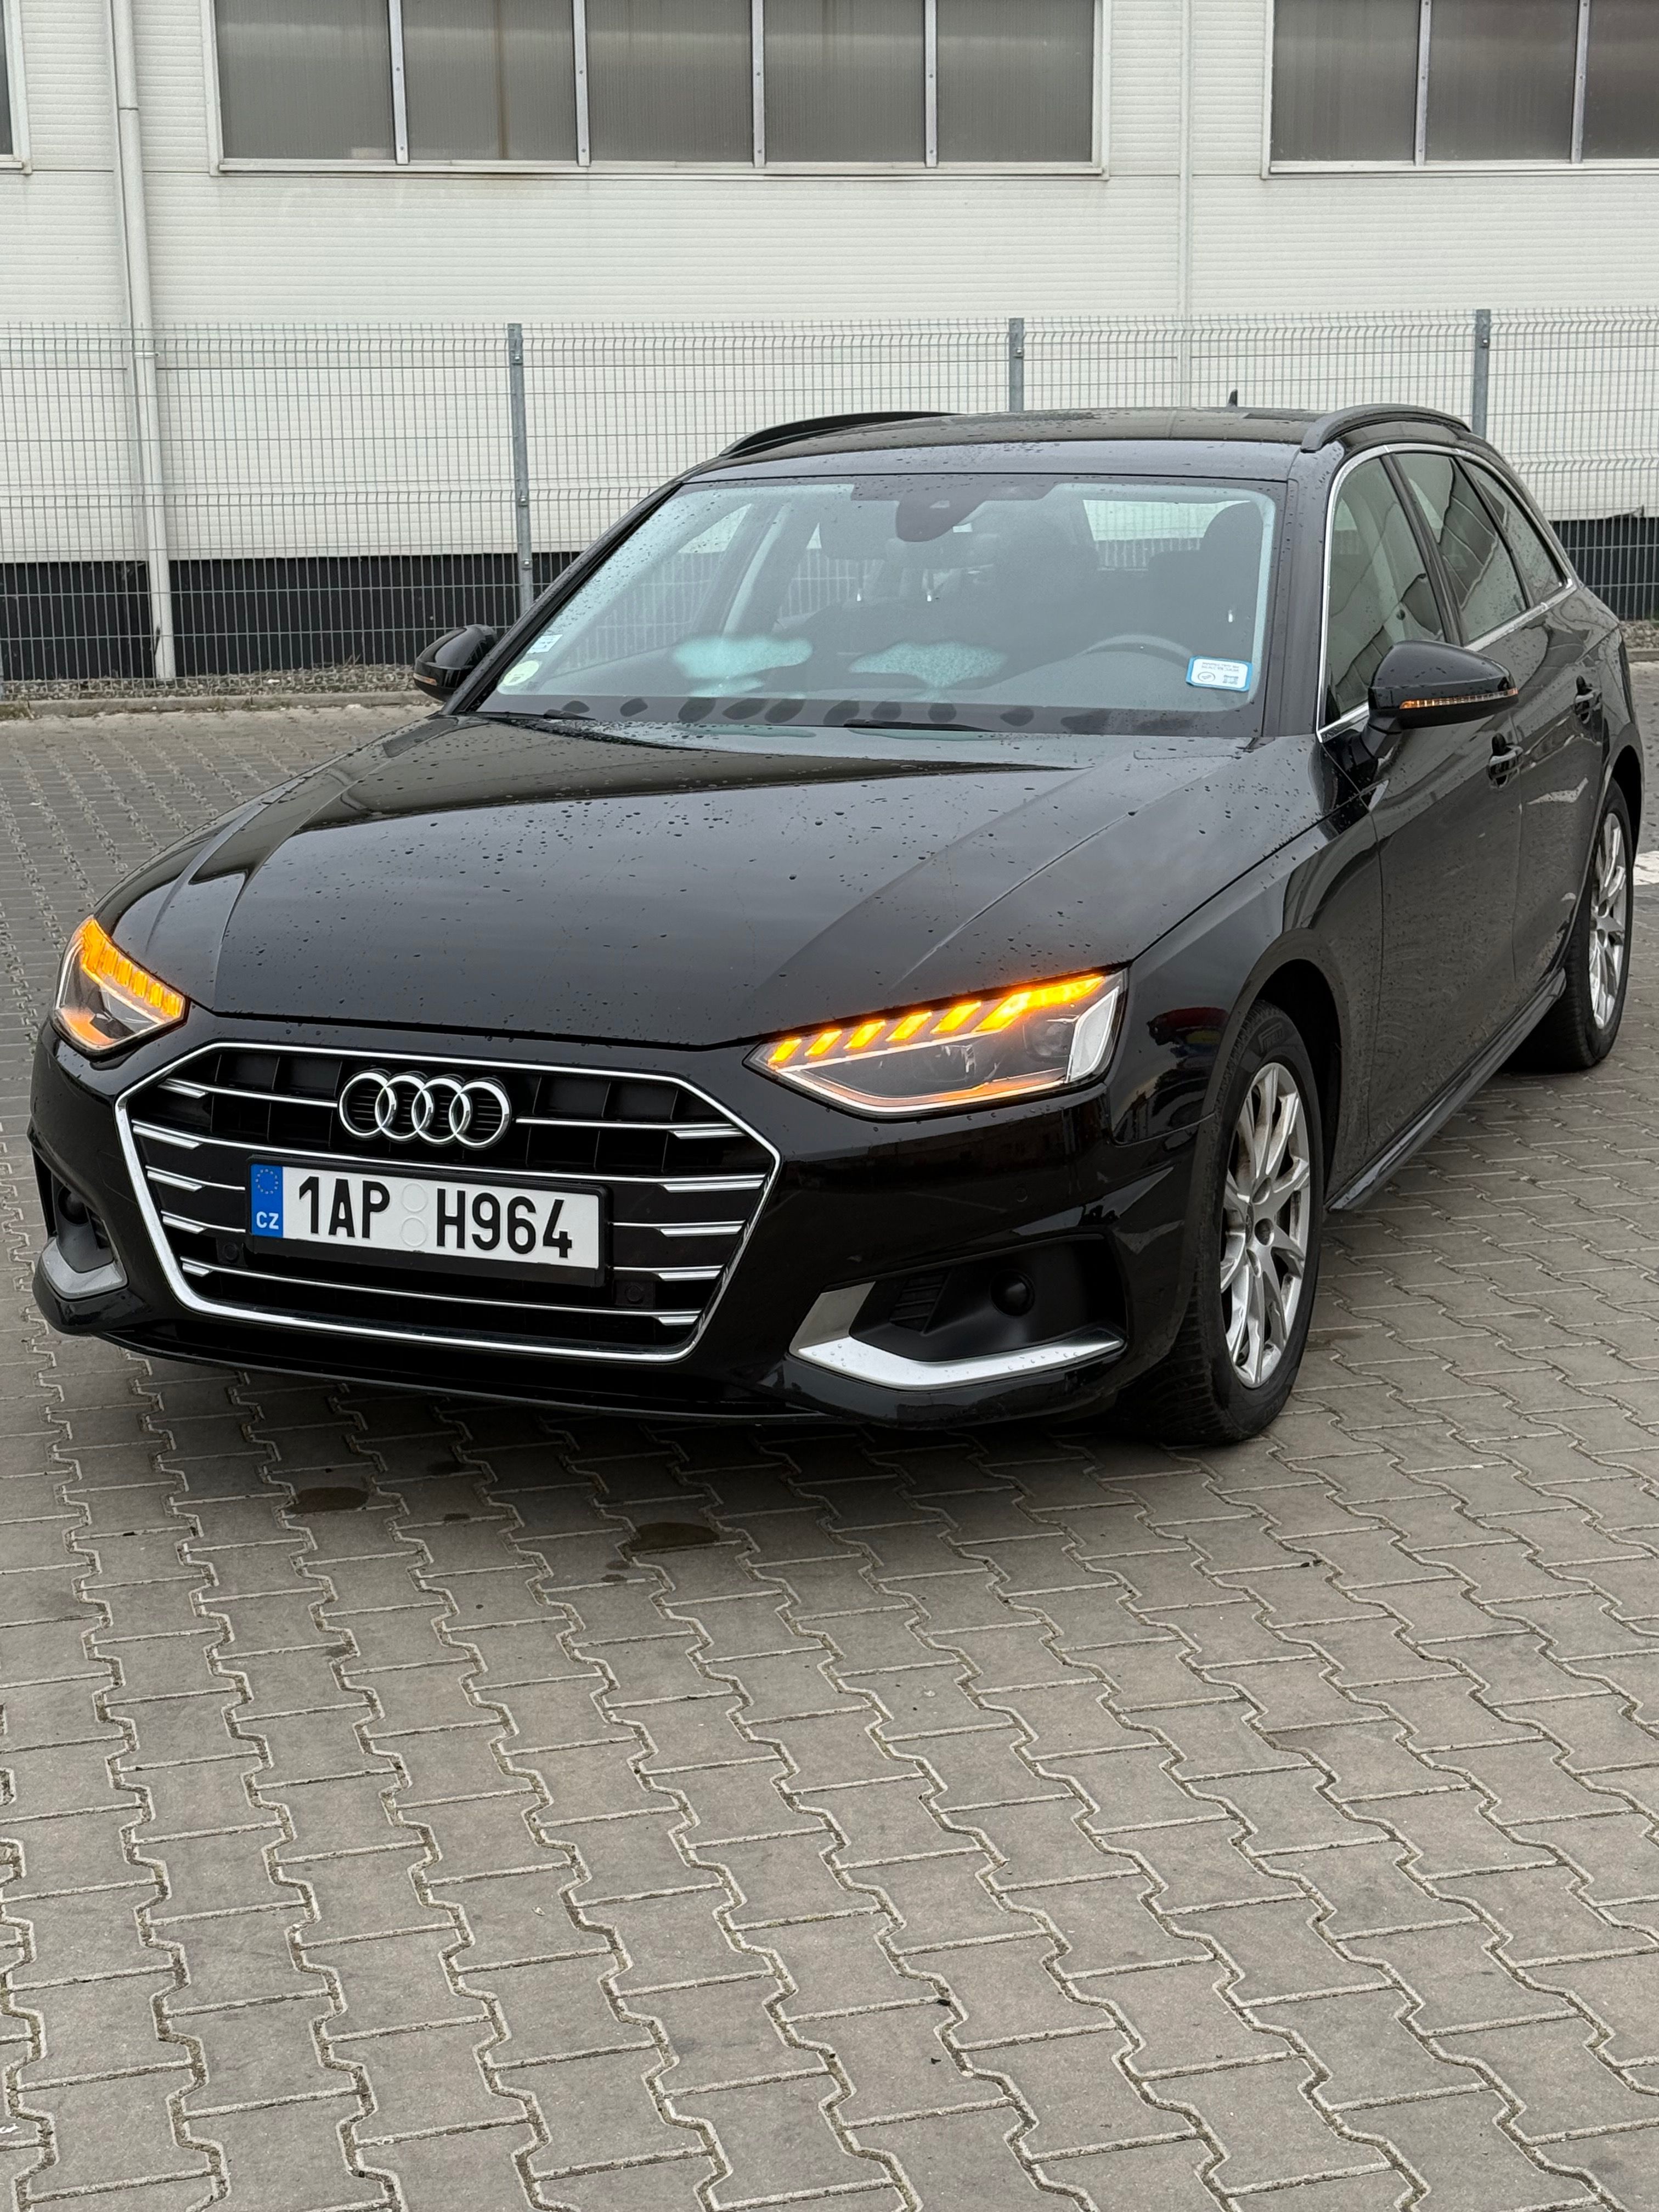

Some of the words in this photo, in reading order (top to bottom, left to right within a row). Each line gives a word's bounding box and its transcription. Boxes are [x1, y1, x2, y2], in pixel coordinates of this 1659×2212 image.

[256, 1211, 279, 1229] CZ
[299, 1176, 390, 1239] 1AP
[437, 1188, 572, 1259] H964
